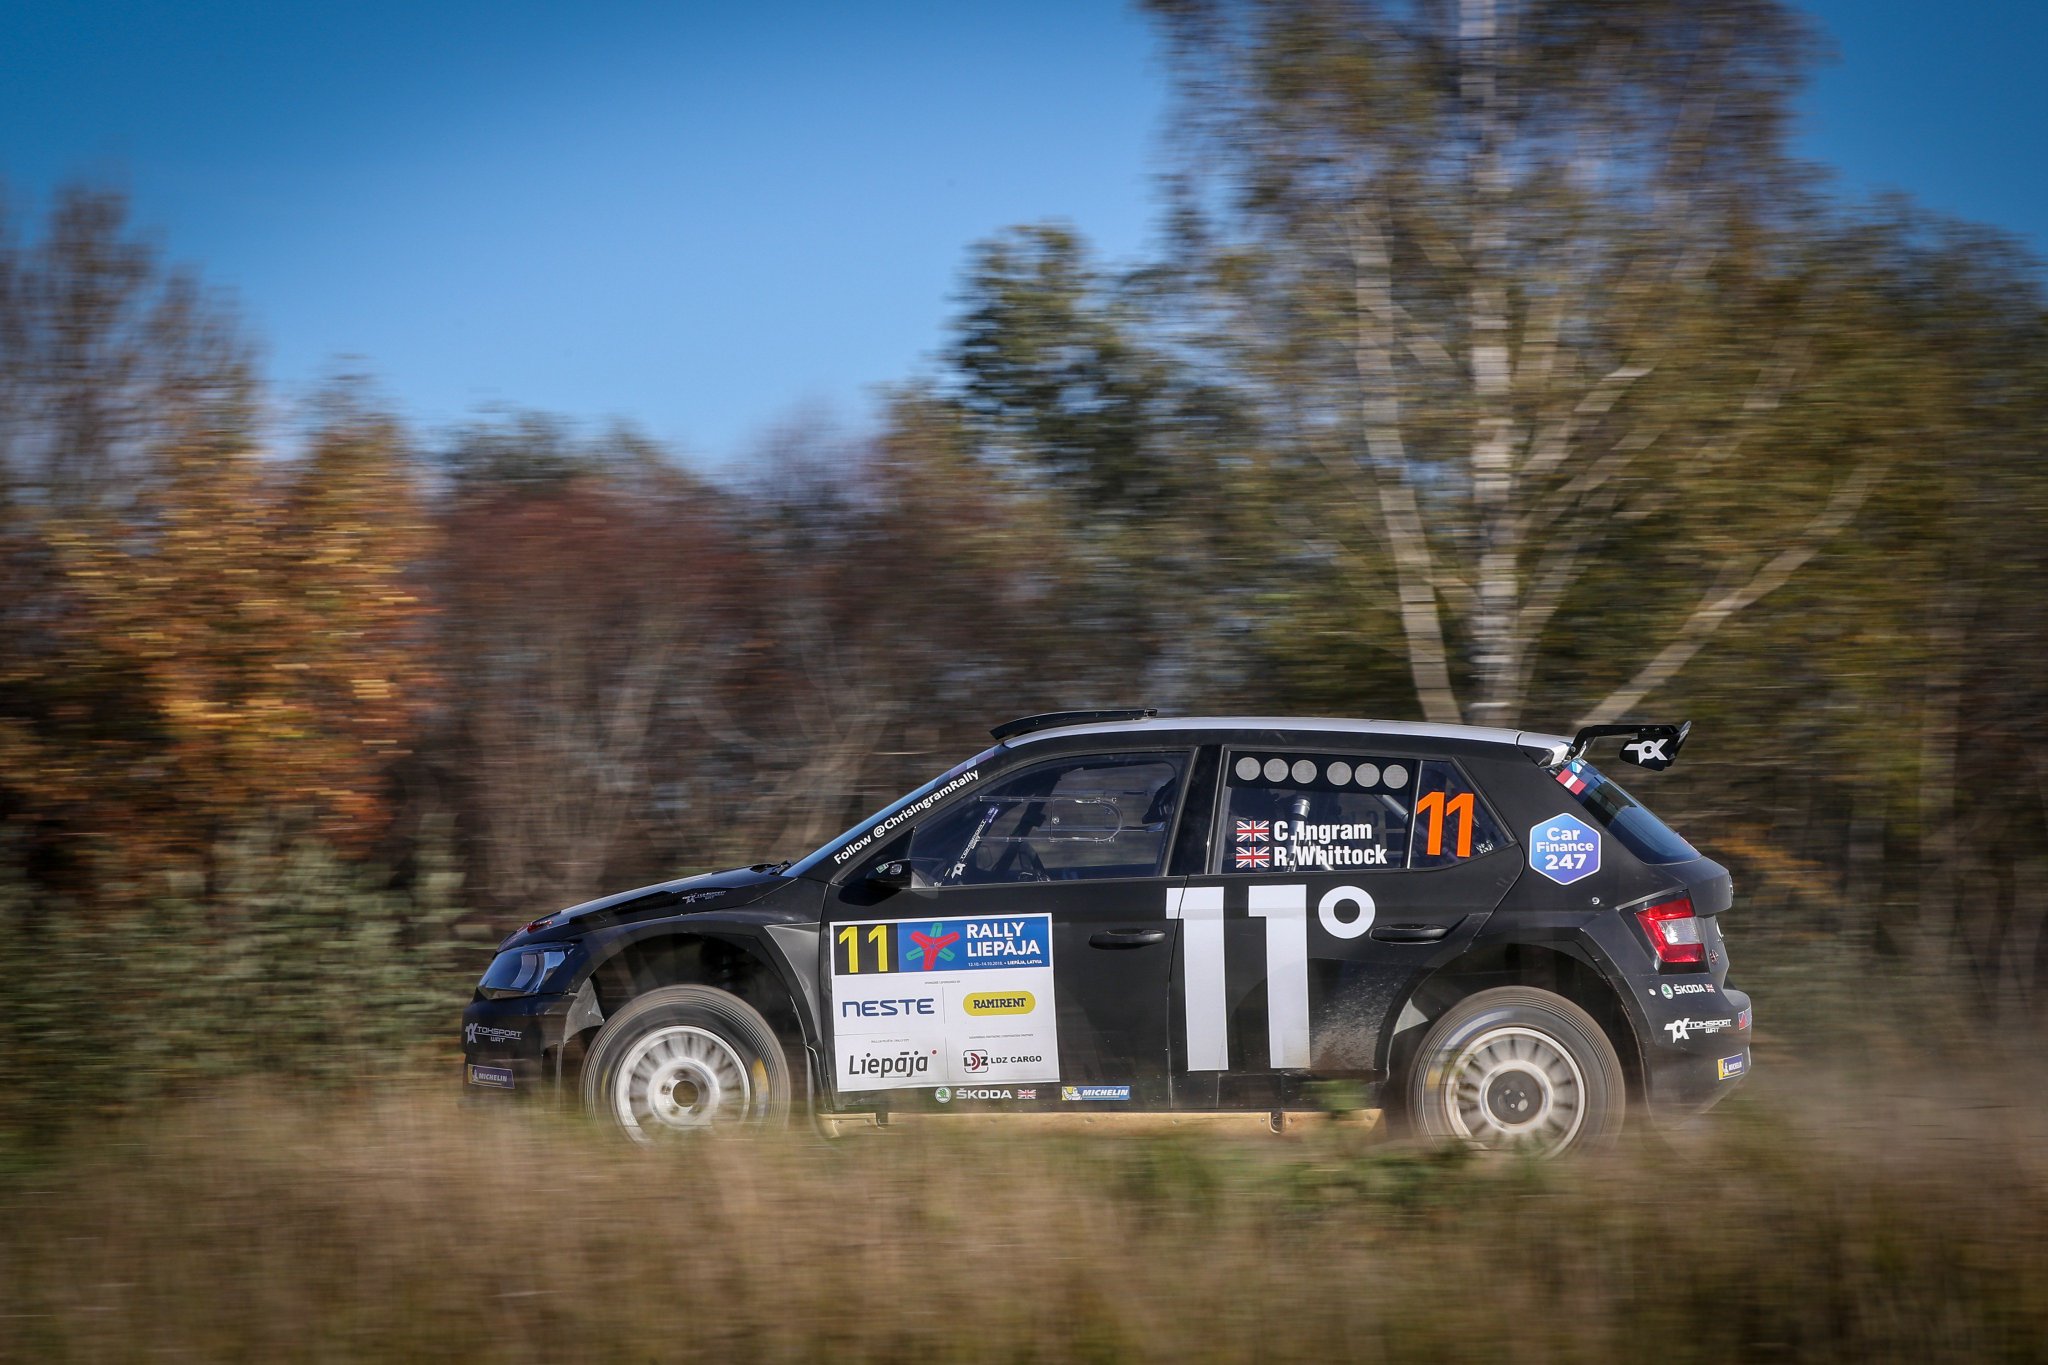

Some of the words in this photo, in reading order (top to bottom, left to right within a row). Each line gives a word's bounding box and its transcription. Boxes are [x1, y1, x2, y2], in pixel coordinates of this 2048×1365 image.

[834, 835, 872, 864] Follow
[873, 770, 980, 838] @ChrisIngramRally
[1416, 791, 1475, 858] 11
[1546, 827, 1581, 841] Car
[1536, 841, 1595, 853] Finance
[1273, 845, 1387, 867] R.Whittock
[1545, 853, 1587, 870] 247
[966, 922, 1025, 939] RALLY
[838, 924, 889, 974] 11
[967, 937, 1041, 957] LIEPĀJA
[1673, 983, 1705, 995] ŠKODA
[842, 998, 935, 1018] NESTE
[973, 998, 1026, 1009] RAMIRENT
[848, 1050, 929, 1078] Liepāja
[990, 1056, 1008, 1064] LDZ
[1010, 1055, 1042, 1063] CARGO
[478, 1073, 508, 1082] MICHELIN
[956, 1088, 1012, 1099] ŠKODA
[1082, 1088, 1128, 1097] MICHELIN
